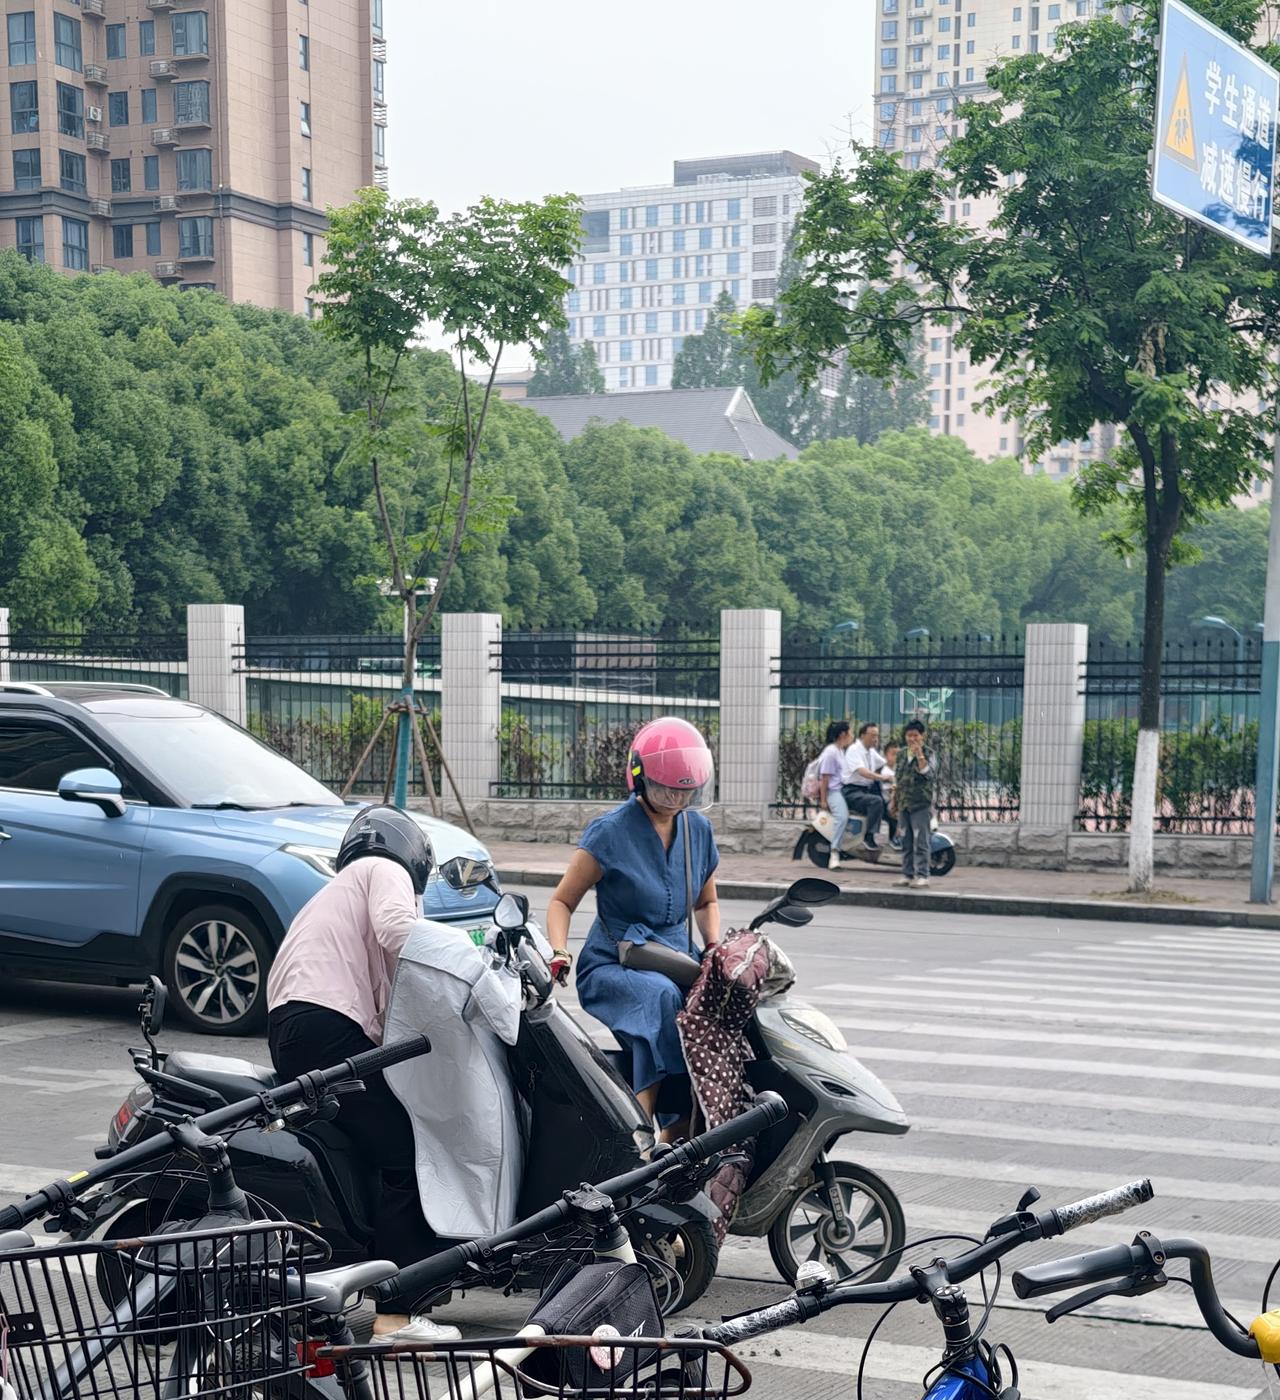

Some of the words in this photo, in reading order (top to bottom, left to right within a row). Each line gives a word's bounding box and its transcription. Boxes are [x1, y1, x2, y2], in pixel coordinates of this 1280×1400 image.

[1204, 60, 1271, 150] 学生通道
[1200, 141, 1268, 222] 减速慢行
